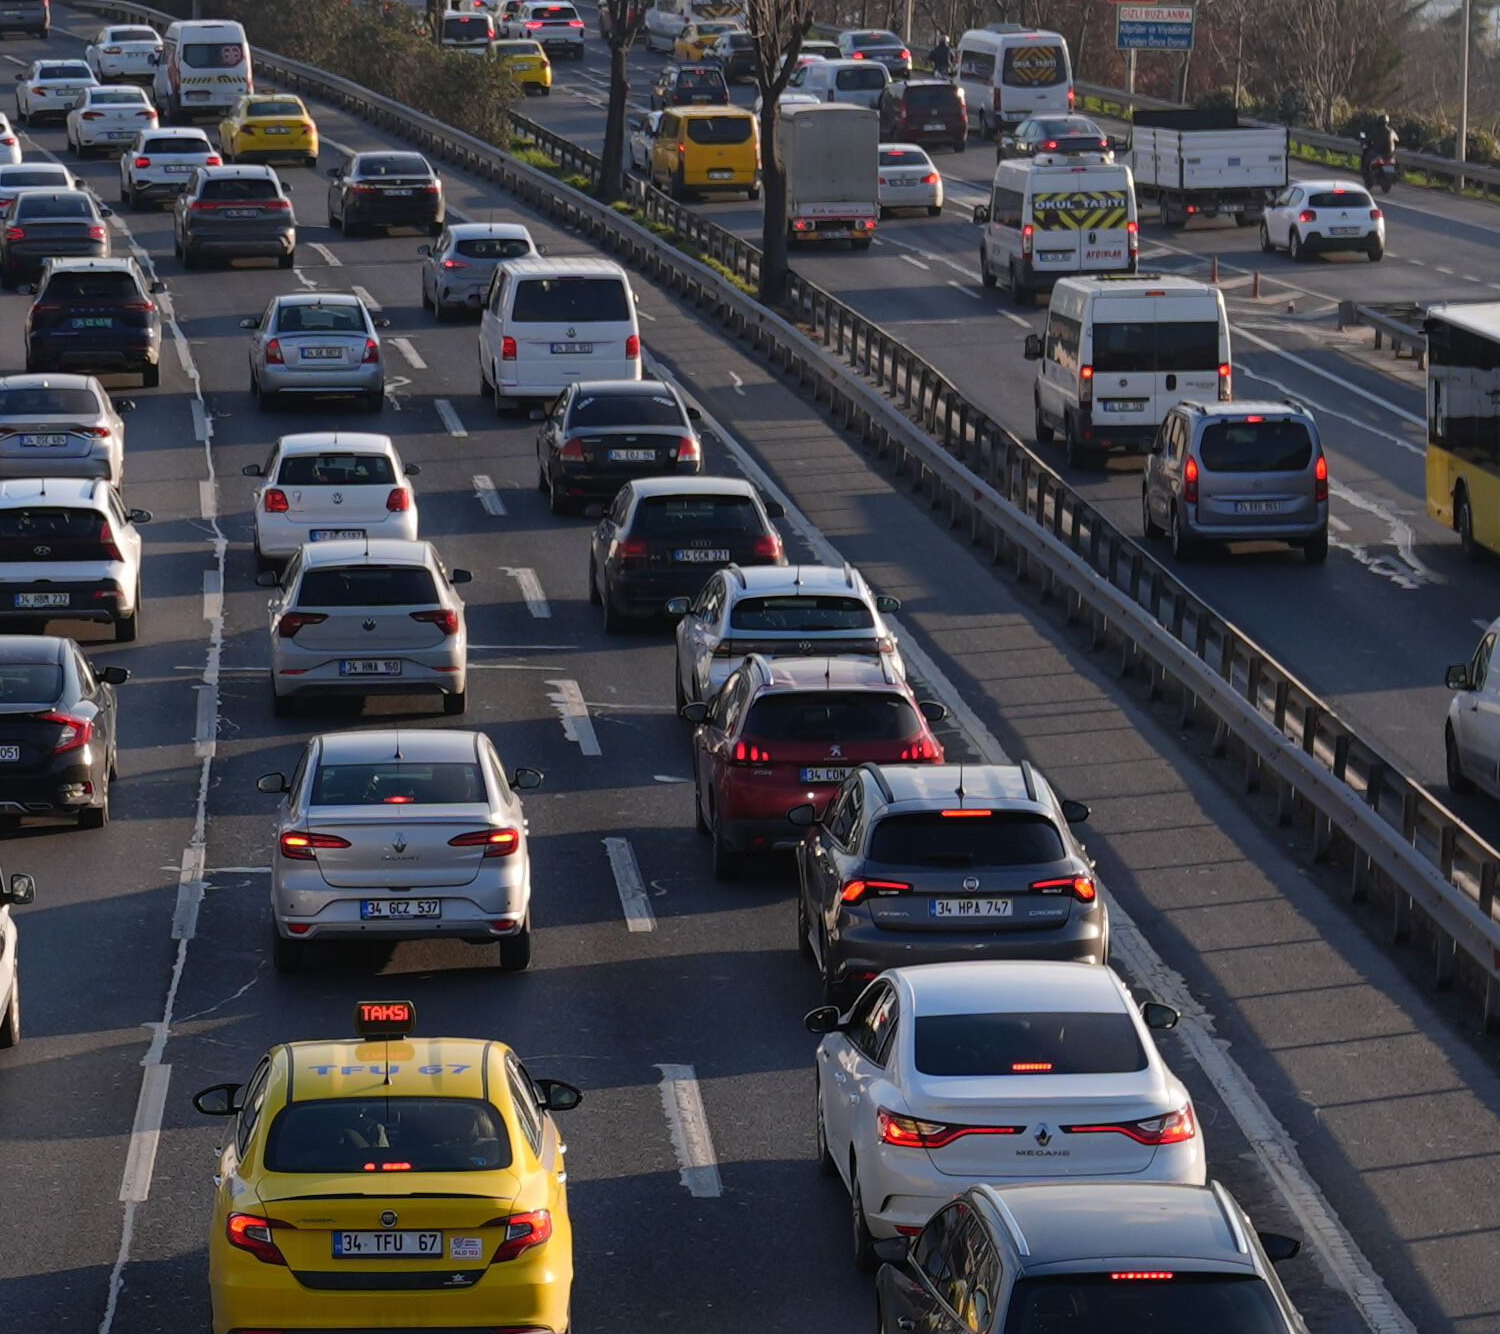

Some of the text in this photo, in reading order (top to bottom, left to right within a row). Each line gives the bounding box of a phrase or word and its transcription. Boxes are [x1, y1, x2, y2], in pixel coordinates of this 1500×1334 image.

[1145, 9, 1190, 21] BUZLANMA
[1035, 199, 1074, 210] OKUL
[20, 594, 31, 604] 34
[52, 594, 68, 604] 232
[347, 662, 357, 672] 34
[0, 747, 18, 759] 051
[809, 769, 821, 781] 34
[368, 901, 438, 916] 34 GCZ 537
[938, 899, 1008, 915] 34 HPA 747
[310, 1064, 472, 1076] TFU 67
[1015, 1149, 1071, 1157] MEGANE
[343, 1233, 439, 1252] 34 TFU 67
